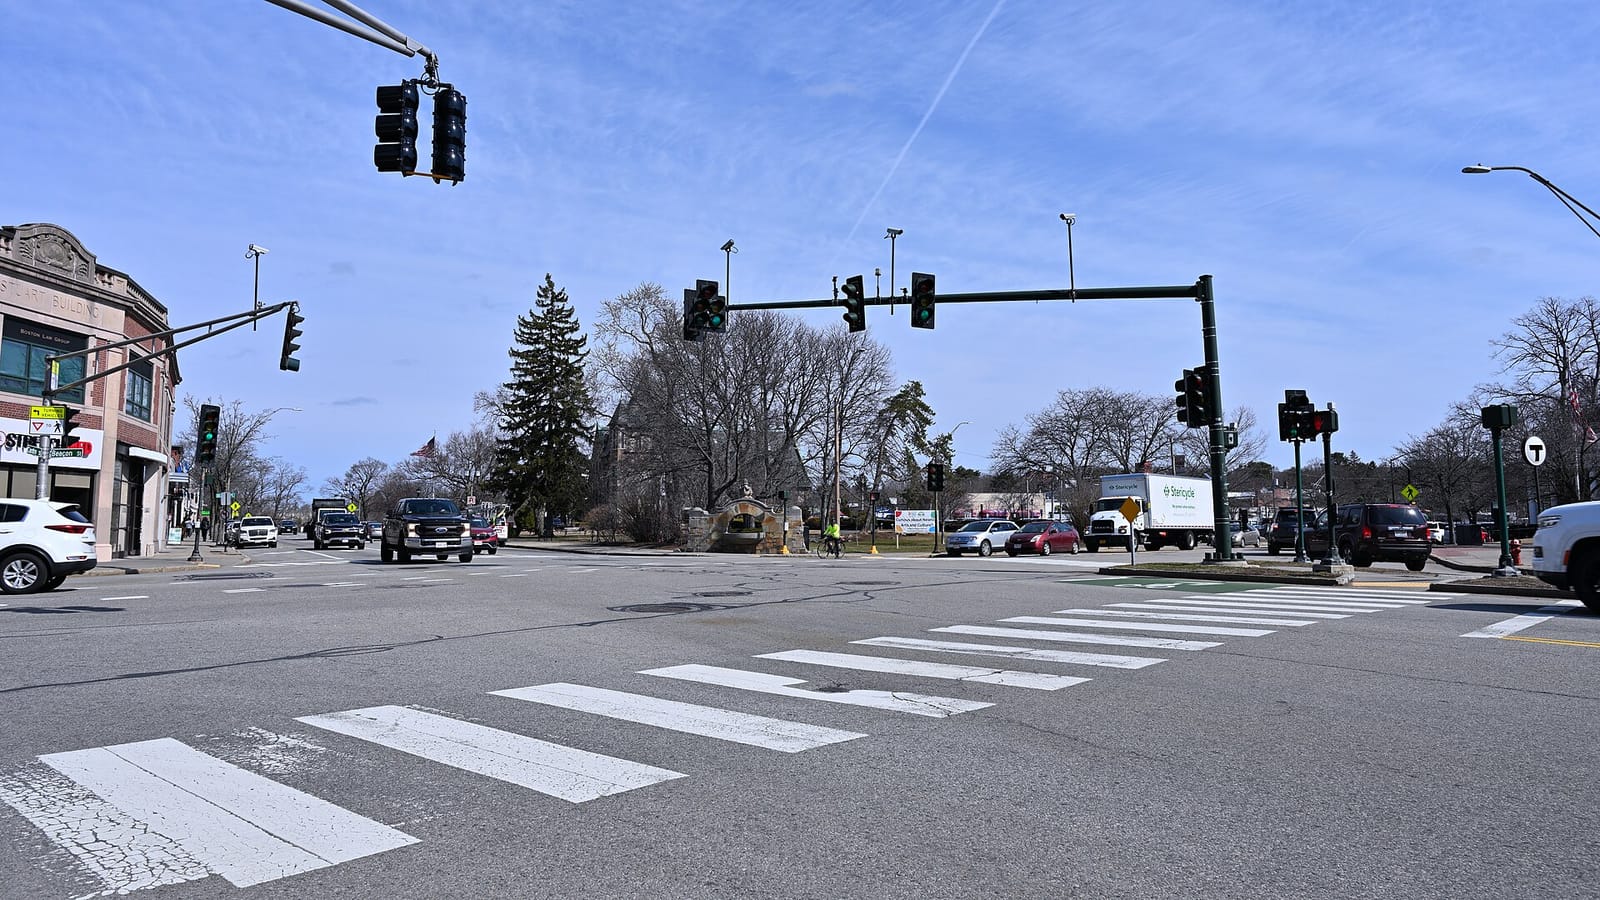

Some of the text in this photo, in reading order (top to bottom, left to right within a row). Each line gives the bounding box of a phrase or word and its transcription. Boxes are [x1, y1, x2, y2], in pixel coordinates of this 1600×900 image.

[52, 295, 99, 318] BUILDING
[1529, 445, 1543, 461] T
[1115, 483, 1138, 491] Stericycle
[1171, 485, 1195, 500] Stericycle
